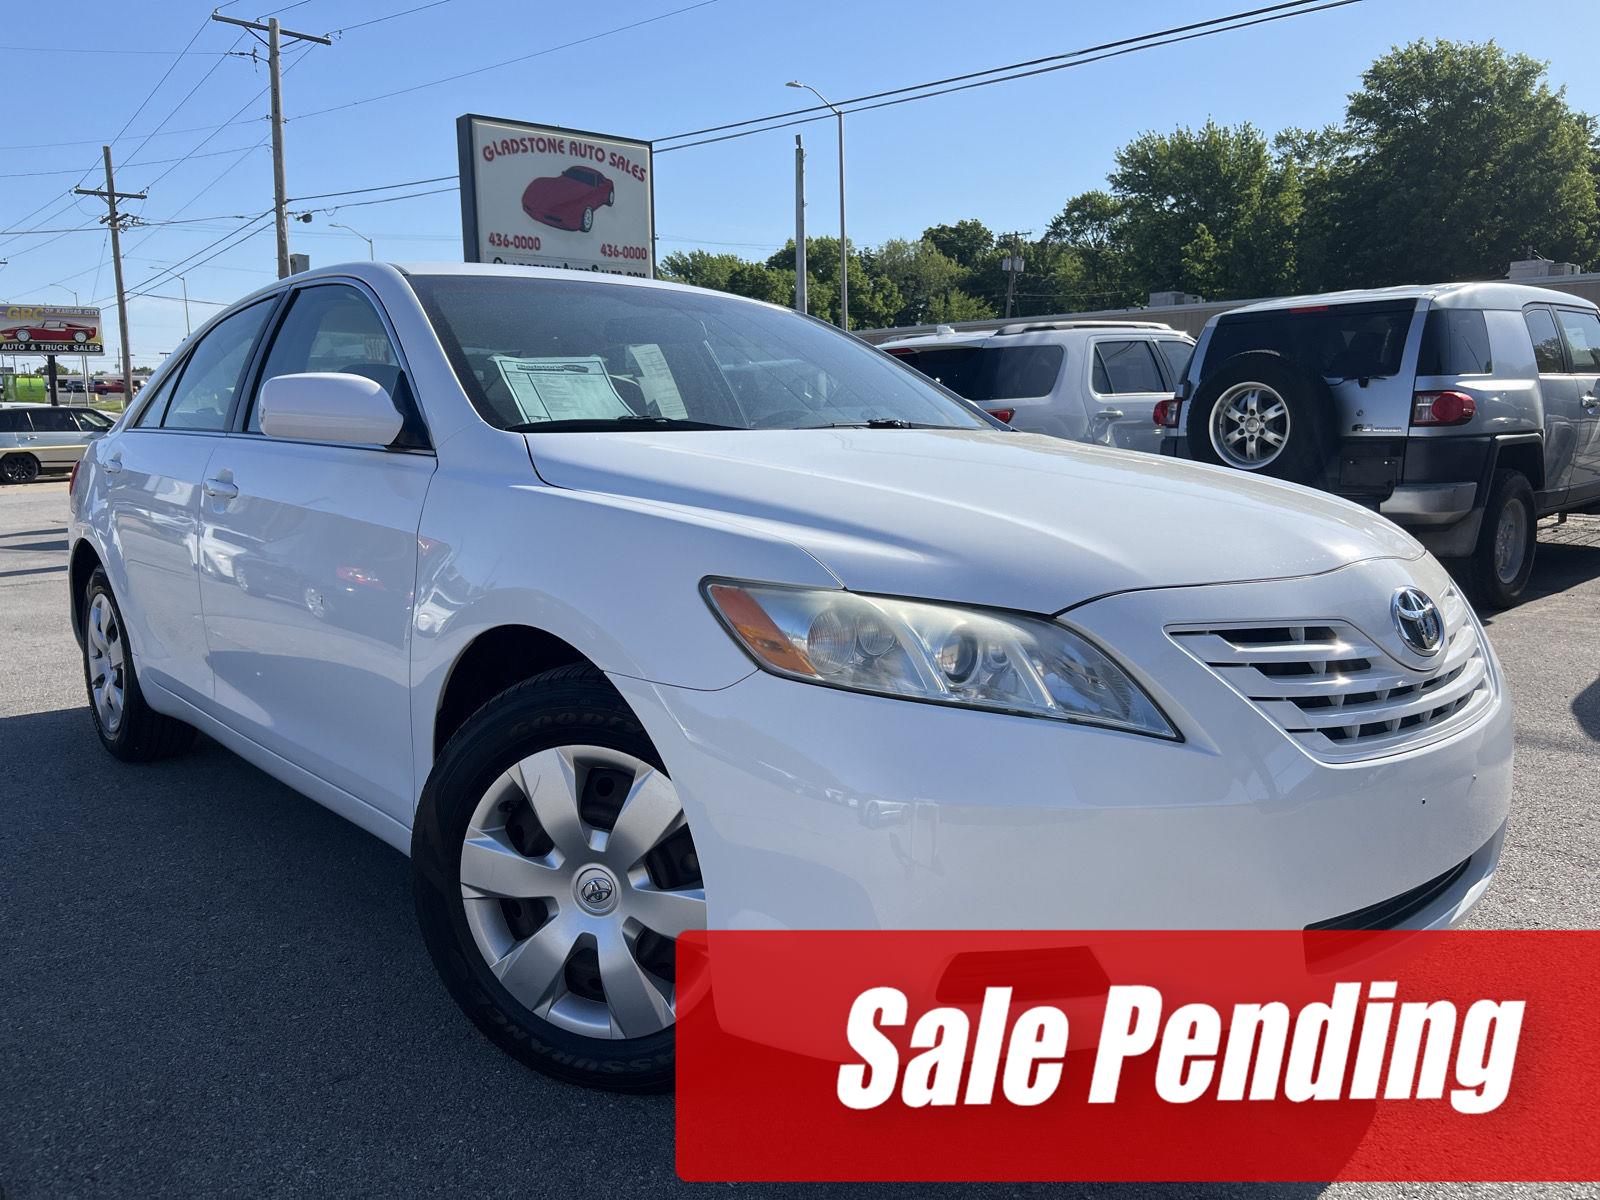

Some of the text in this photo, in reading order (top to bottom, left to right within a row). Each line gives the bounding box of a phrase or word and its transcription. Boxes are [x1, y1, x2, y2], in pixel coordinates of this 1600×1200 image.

[482, 137, 647, 183] GLADSTONE AUTO SALES
[488, 232, 541, 251] 436-0000
[600, 243, 648, 260] 436-0000
[6, 306, 45, 321] GRC
[73, 344, 101, 352] SALES
